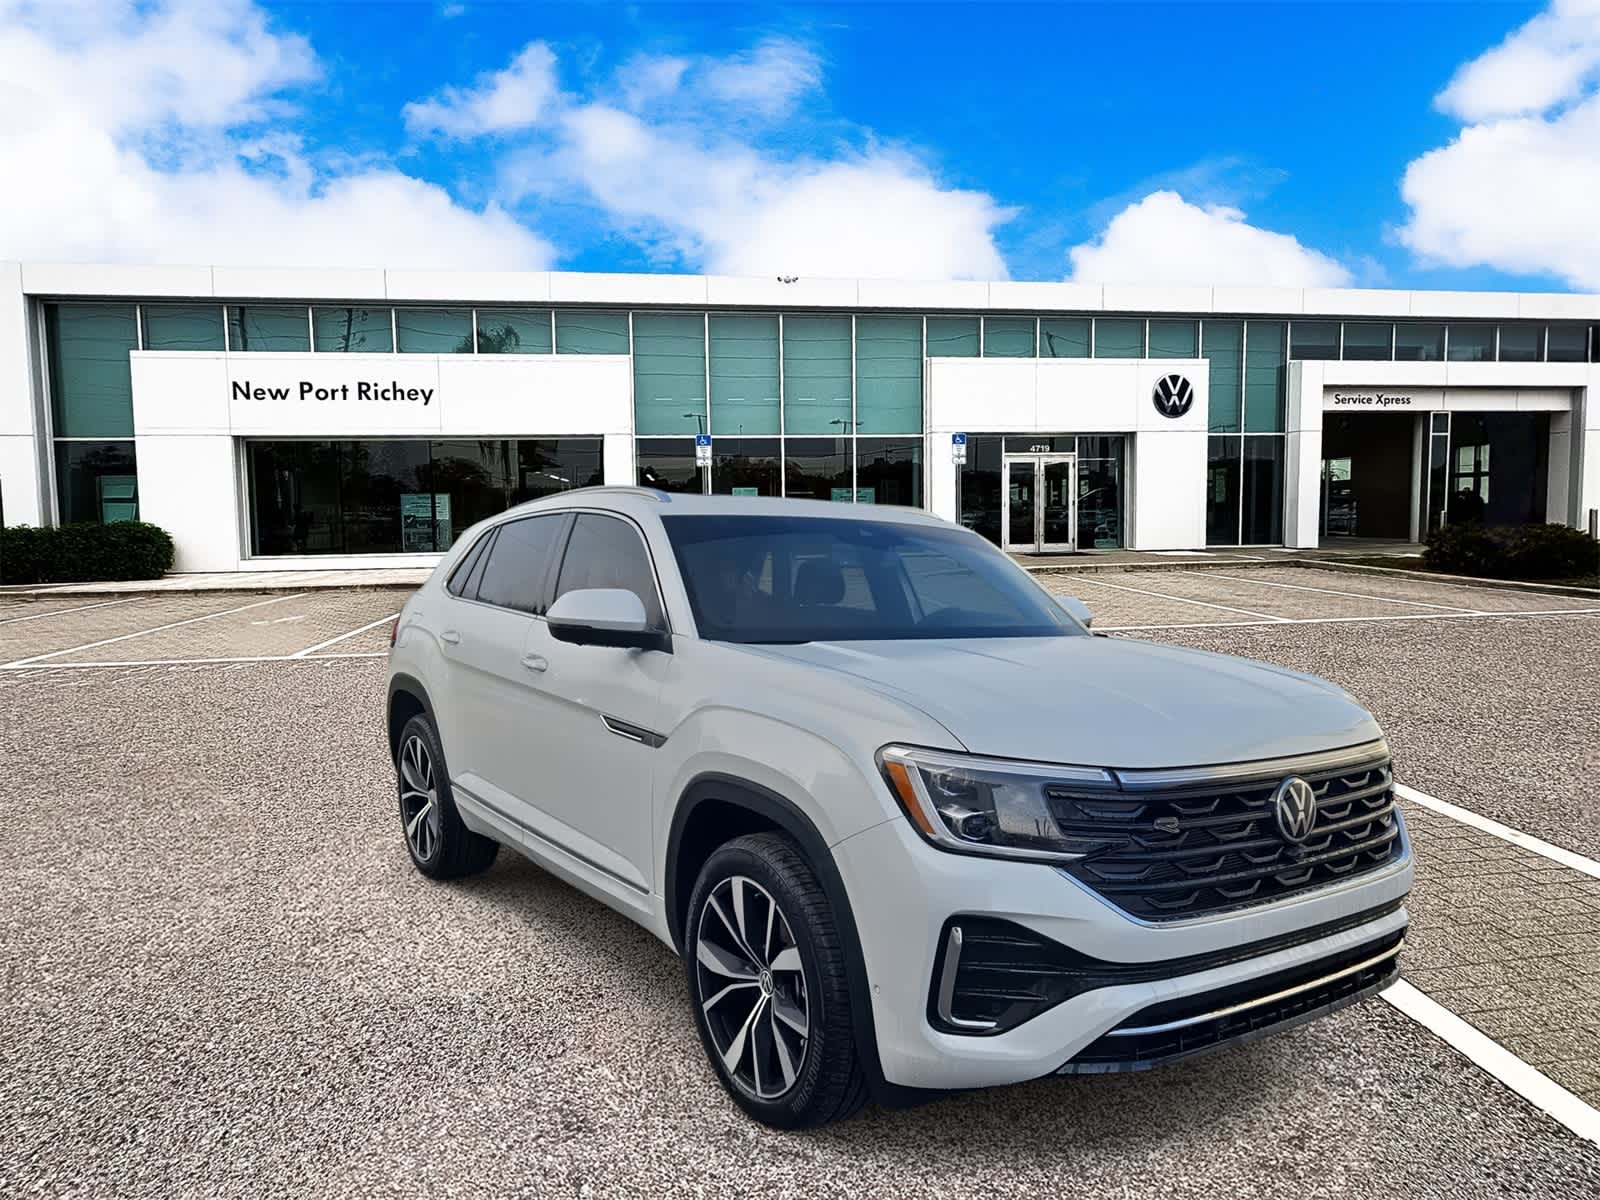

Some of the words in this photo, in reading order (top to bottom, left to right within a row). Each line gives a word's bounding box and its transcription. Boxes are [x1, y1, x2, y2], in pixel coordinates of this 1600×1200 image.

[231, 381, 290, 401] New
[299, 381, 349, 401] Port
[357, 381, 434, 406] Richey
[1334, 393, 1373, 405] Service
[1375, 393, 1412, 407] Xpress
[1030, 444, 1050, 452] 4719
